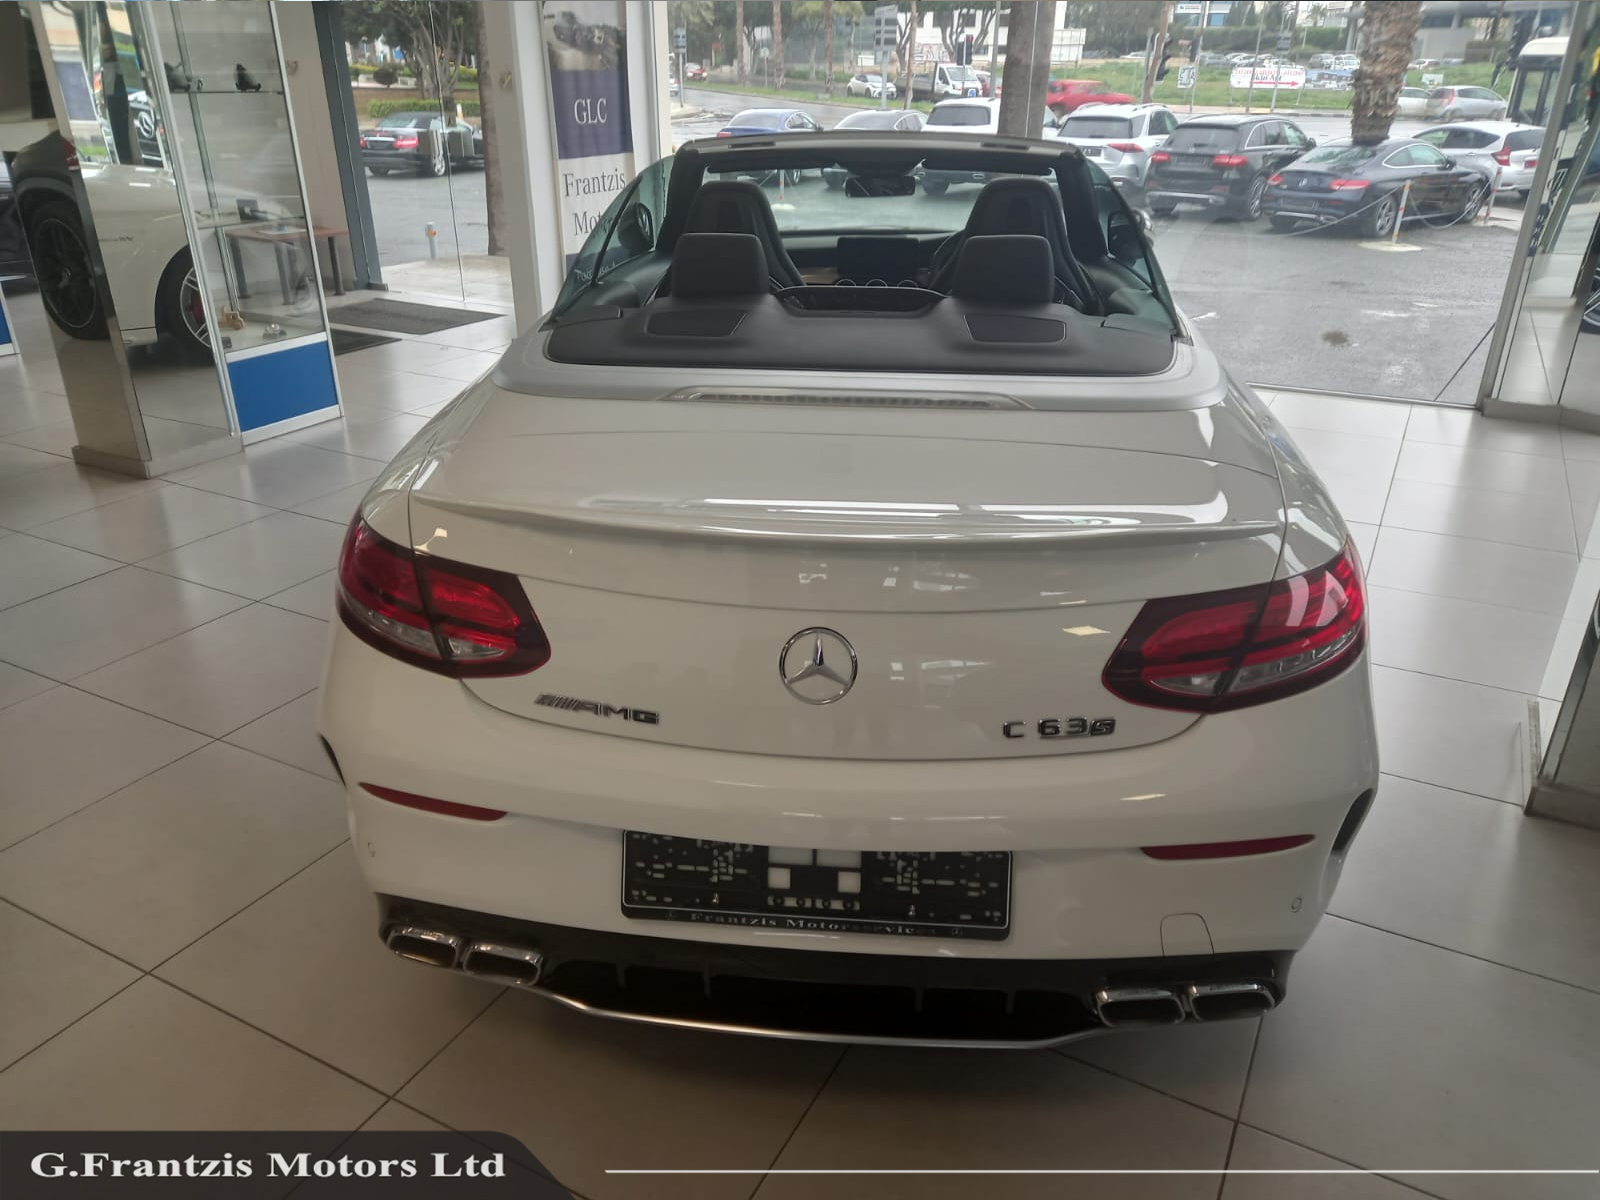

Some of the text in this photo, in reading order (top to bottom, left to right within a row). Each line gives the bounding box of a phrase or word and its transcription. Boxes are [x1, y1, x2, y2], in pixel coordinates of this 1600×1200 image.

[574, 98, 608, 125] GLC
[562, 168, 625, 197] Frantzis
[1003, 720, 1026, 738] C
